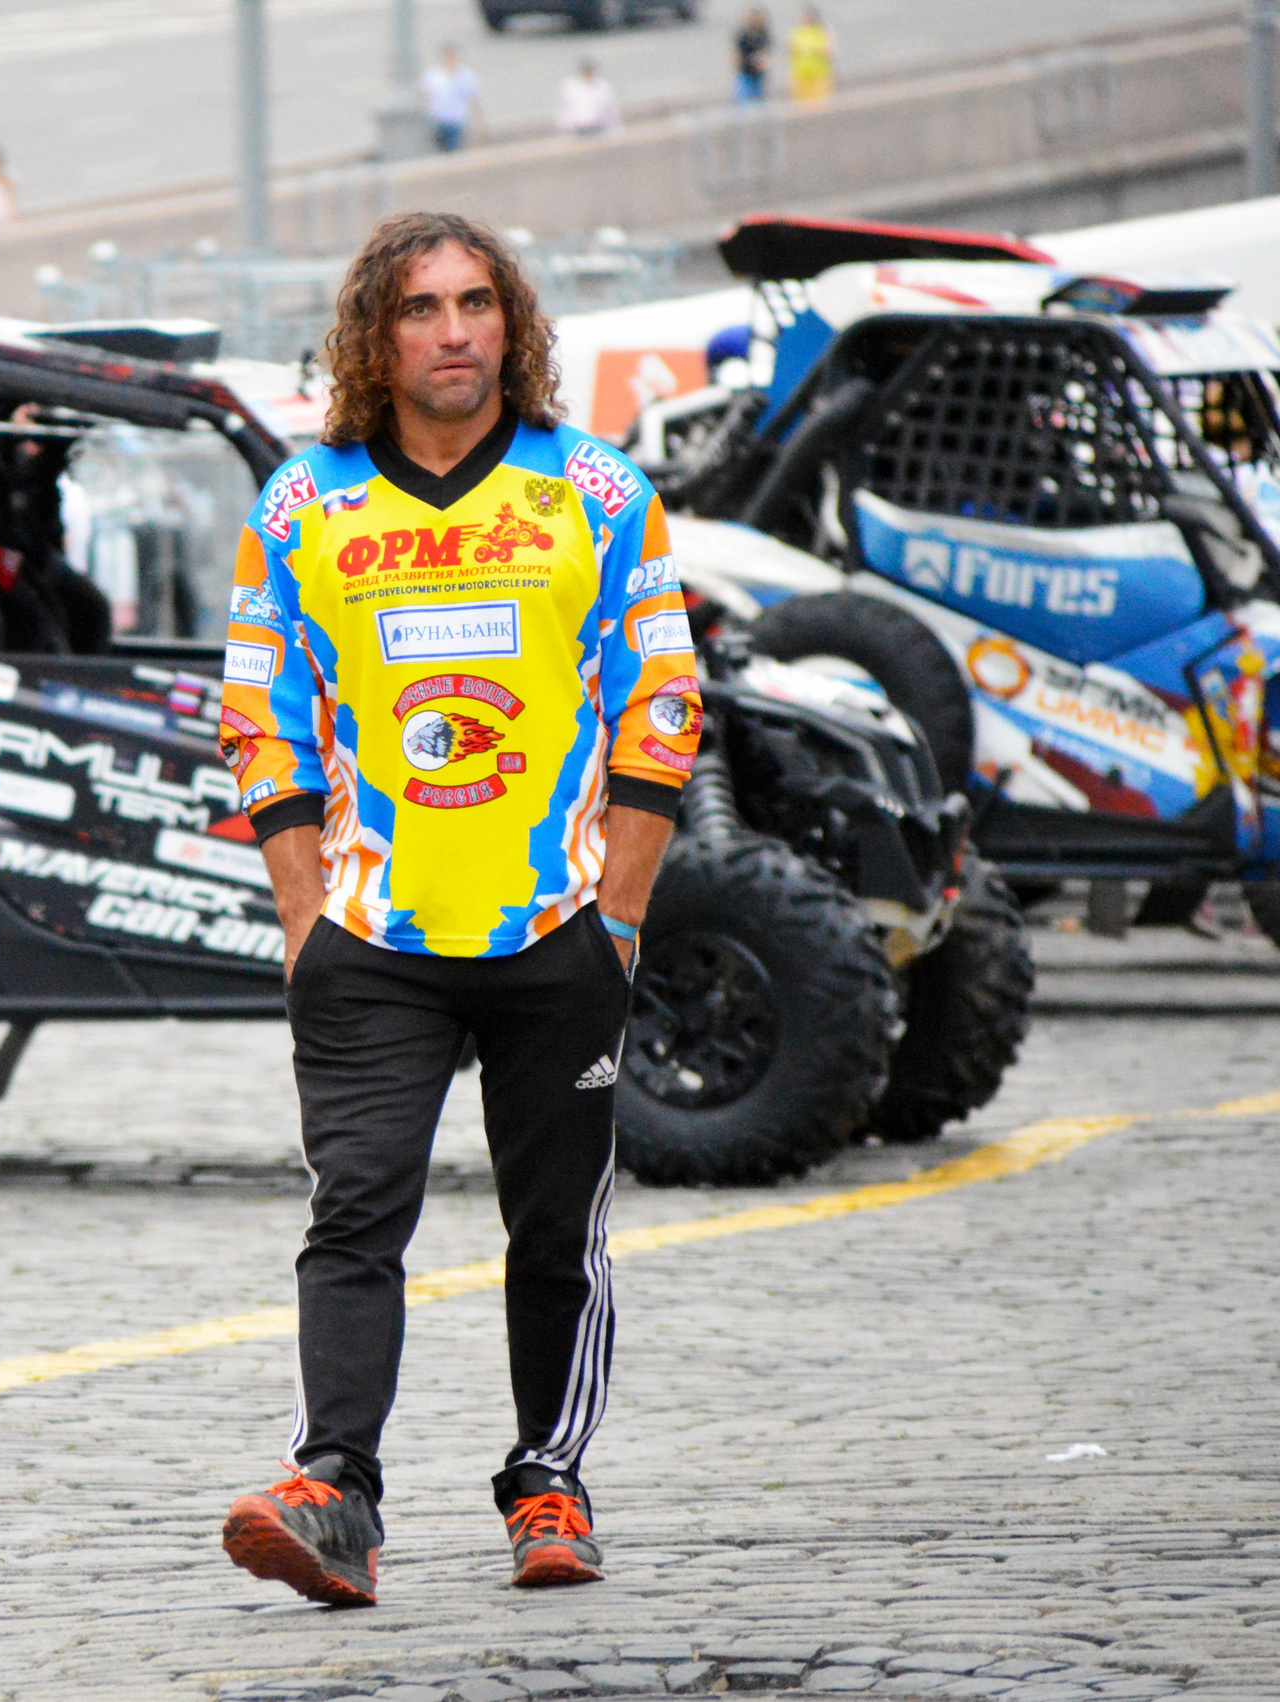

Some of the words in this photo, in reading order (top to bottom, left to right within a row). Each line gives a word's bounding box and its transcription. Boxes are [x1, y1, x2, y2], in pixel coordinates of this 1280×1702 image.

[567, 461, 625, 510] MOLY
[576, 444, 638, 498] LIQUI
[261, 464, 307, 524] LIQUI
[337, 525, 466, 578] ФРМ
[343, 575, 380, 591] ФОНД
[383, 569, 454, 583] РАЗВИТИЯ
[457, 564, 552, 578] МОТОСПОРТА
[344, 593, 365, 605] FUND
[365, 589, 377, 600] OF
[378, 584, 443, 598] DEVELOPMENT
[443, 583, 456, 593] OF
[458, 578, 520, 592] MOTORCYCLE
[521, 579, 550, 588] SPORT
[404, 621, 512, 641] РУНА-БАНК
[227, 655, 270, 673] -БАНК
[463, 678, 517, 713] ВОЛКИ
[1036, 687, 1167, 752] UMMC
[91, 783, 211, 834] TEAM
[419, 781, 494, 805] РОССИЯ
[575, 1072, 616, 1089] adida
